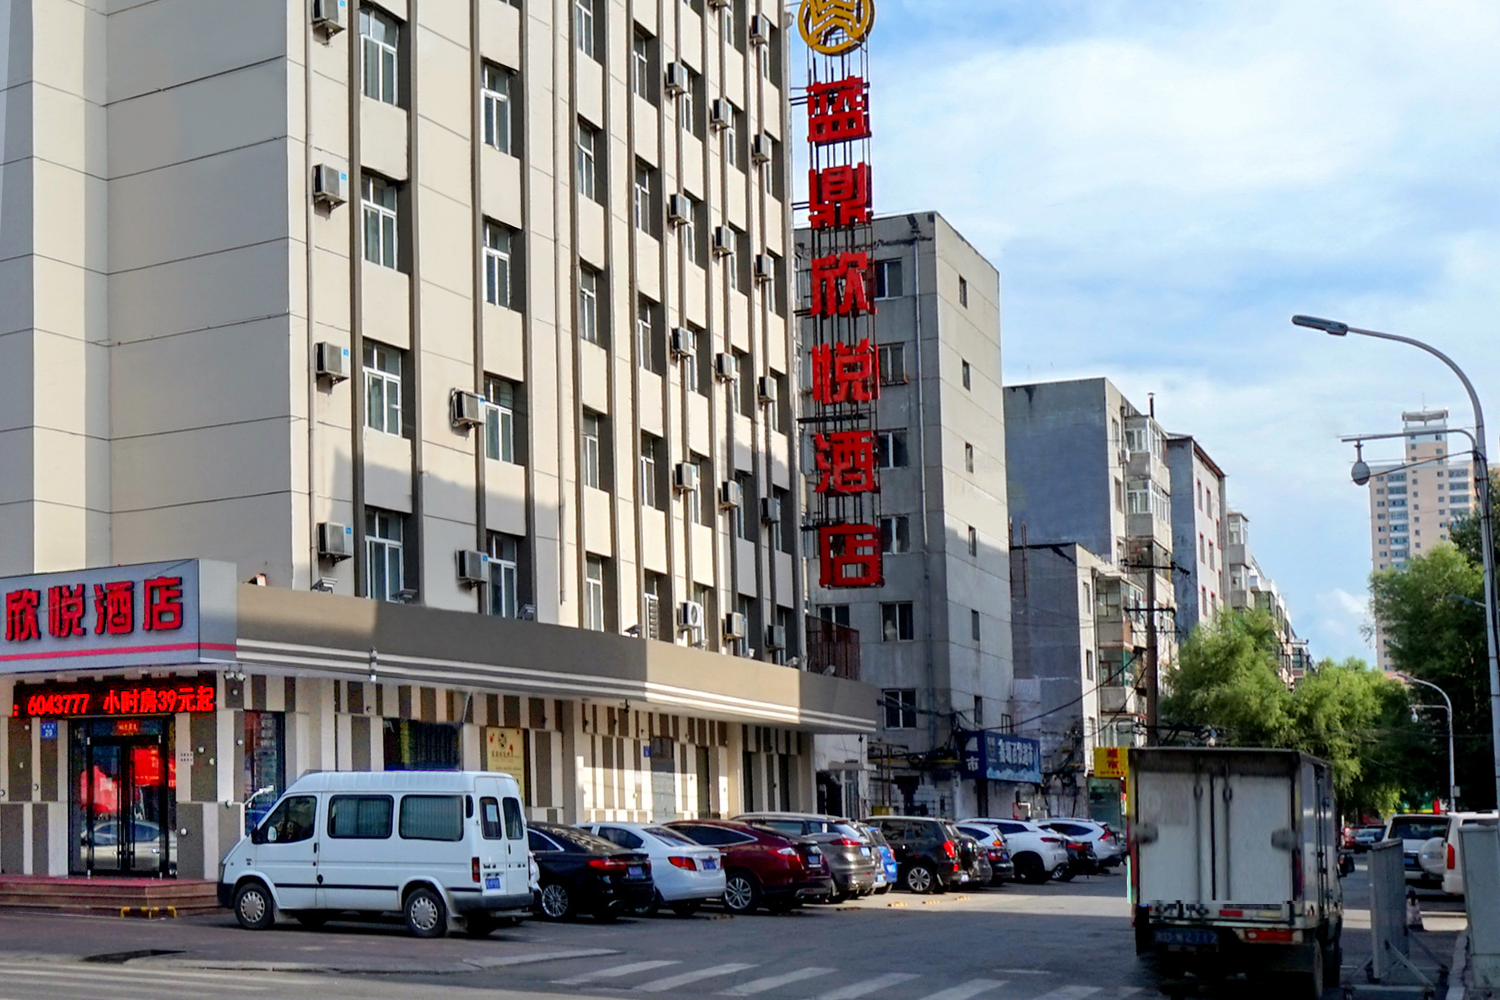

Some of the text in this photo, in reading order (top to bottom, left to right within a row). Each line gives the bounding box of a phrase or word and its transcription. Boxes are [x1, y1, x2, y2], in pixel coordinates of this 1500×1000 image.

[806, 76, 880, 587] 蓝鼎欣悦酒店
[27, 686, 214, 716] 6043777 小时房39元起
